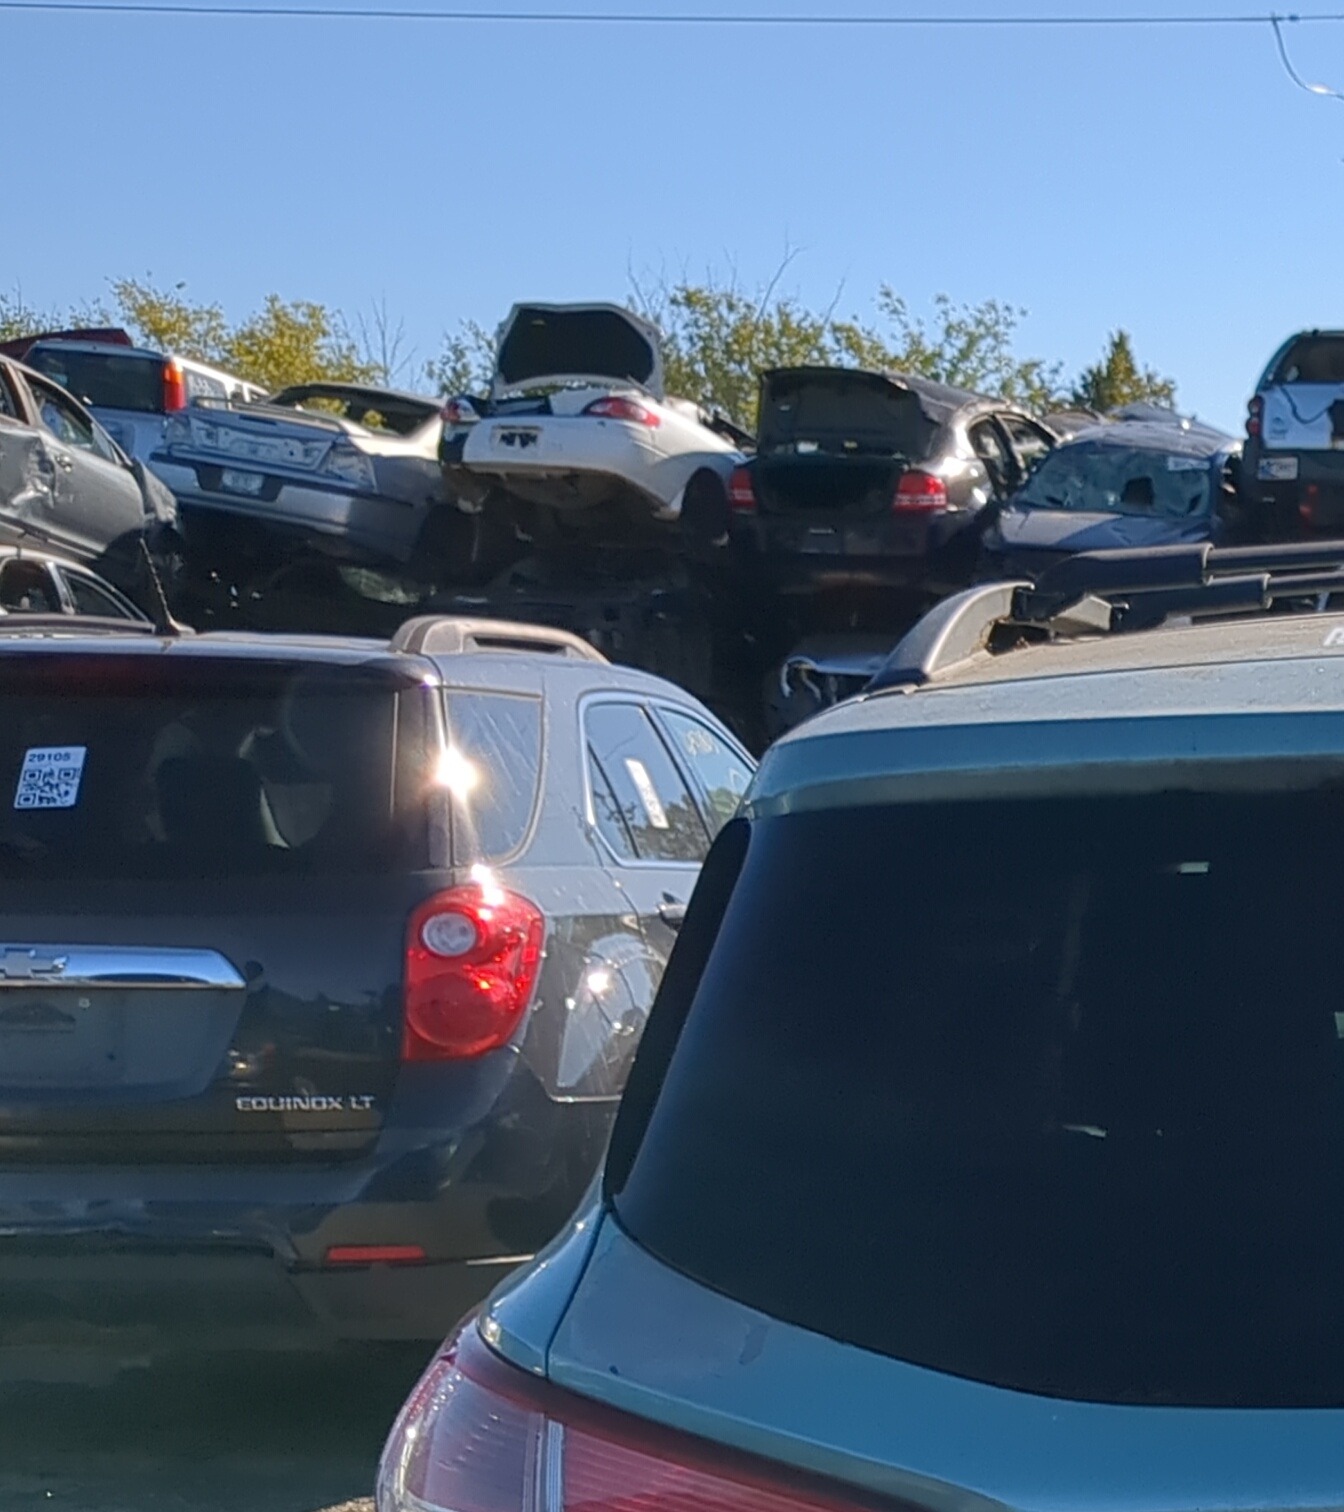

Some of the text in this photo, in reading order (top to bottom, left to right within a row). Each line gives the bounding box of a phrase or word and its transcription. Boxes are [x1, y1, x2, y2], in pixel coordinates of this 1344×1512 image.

[28, 752, 72, 763] 29105
[235, 1095, 377, 1112] EQUINOX LT
